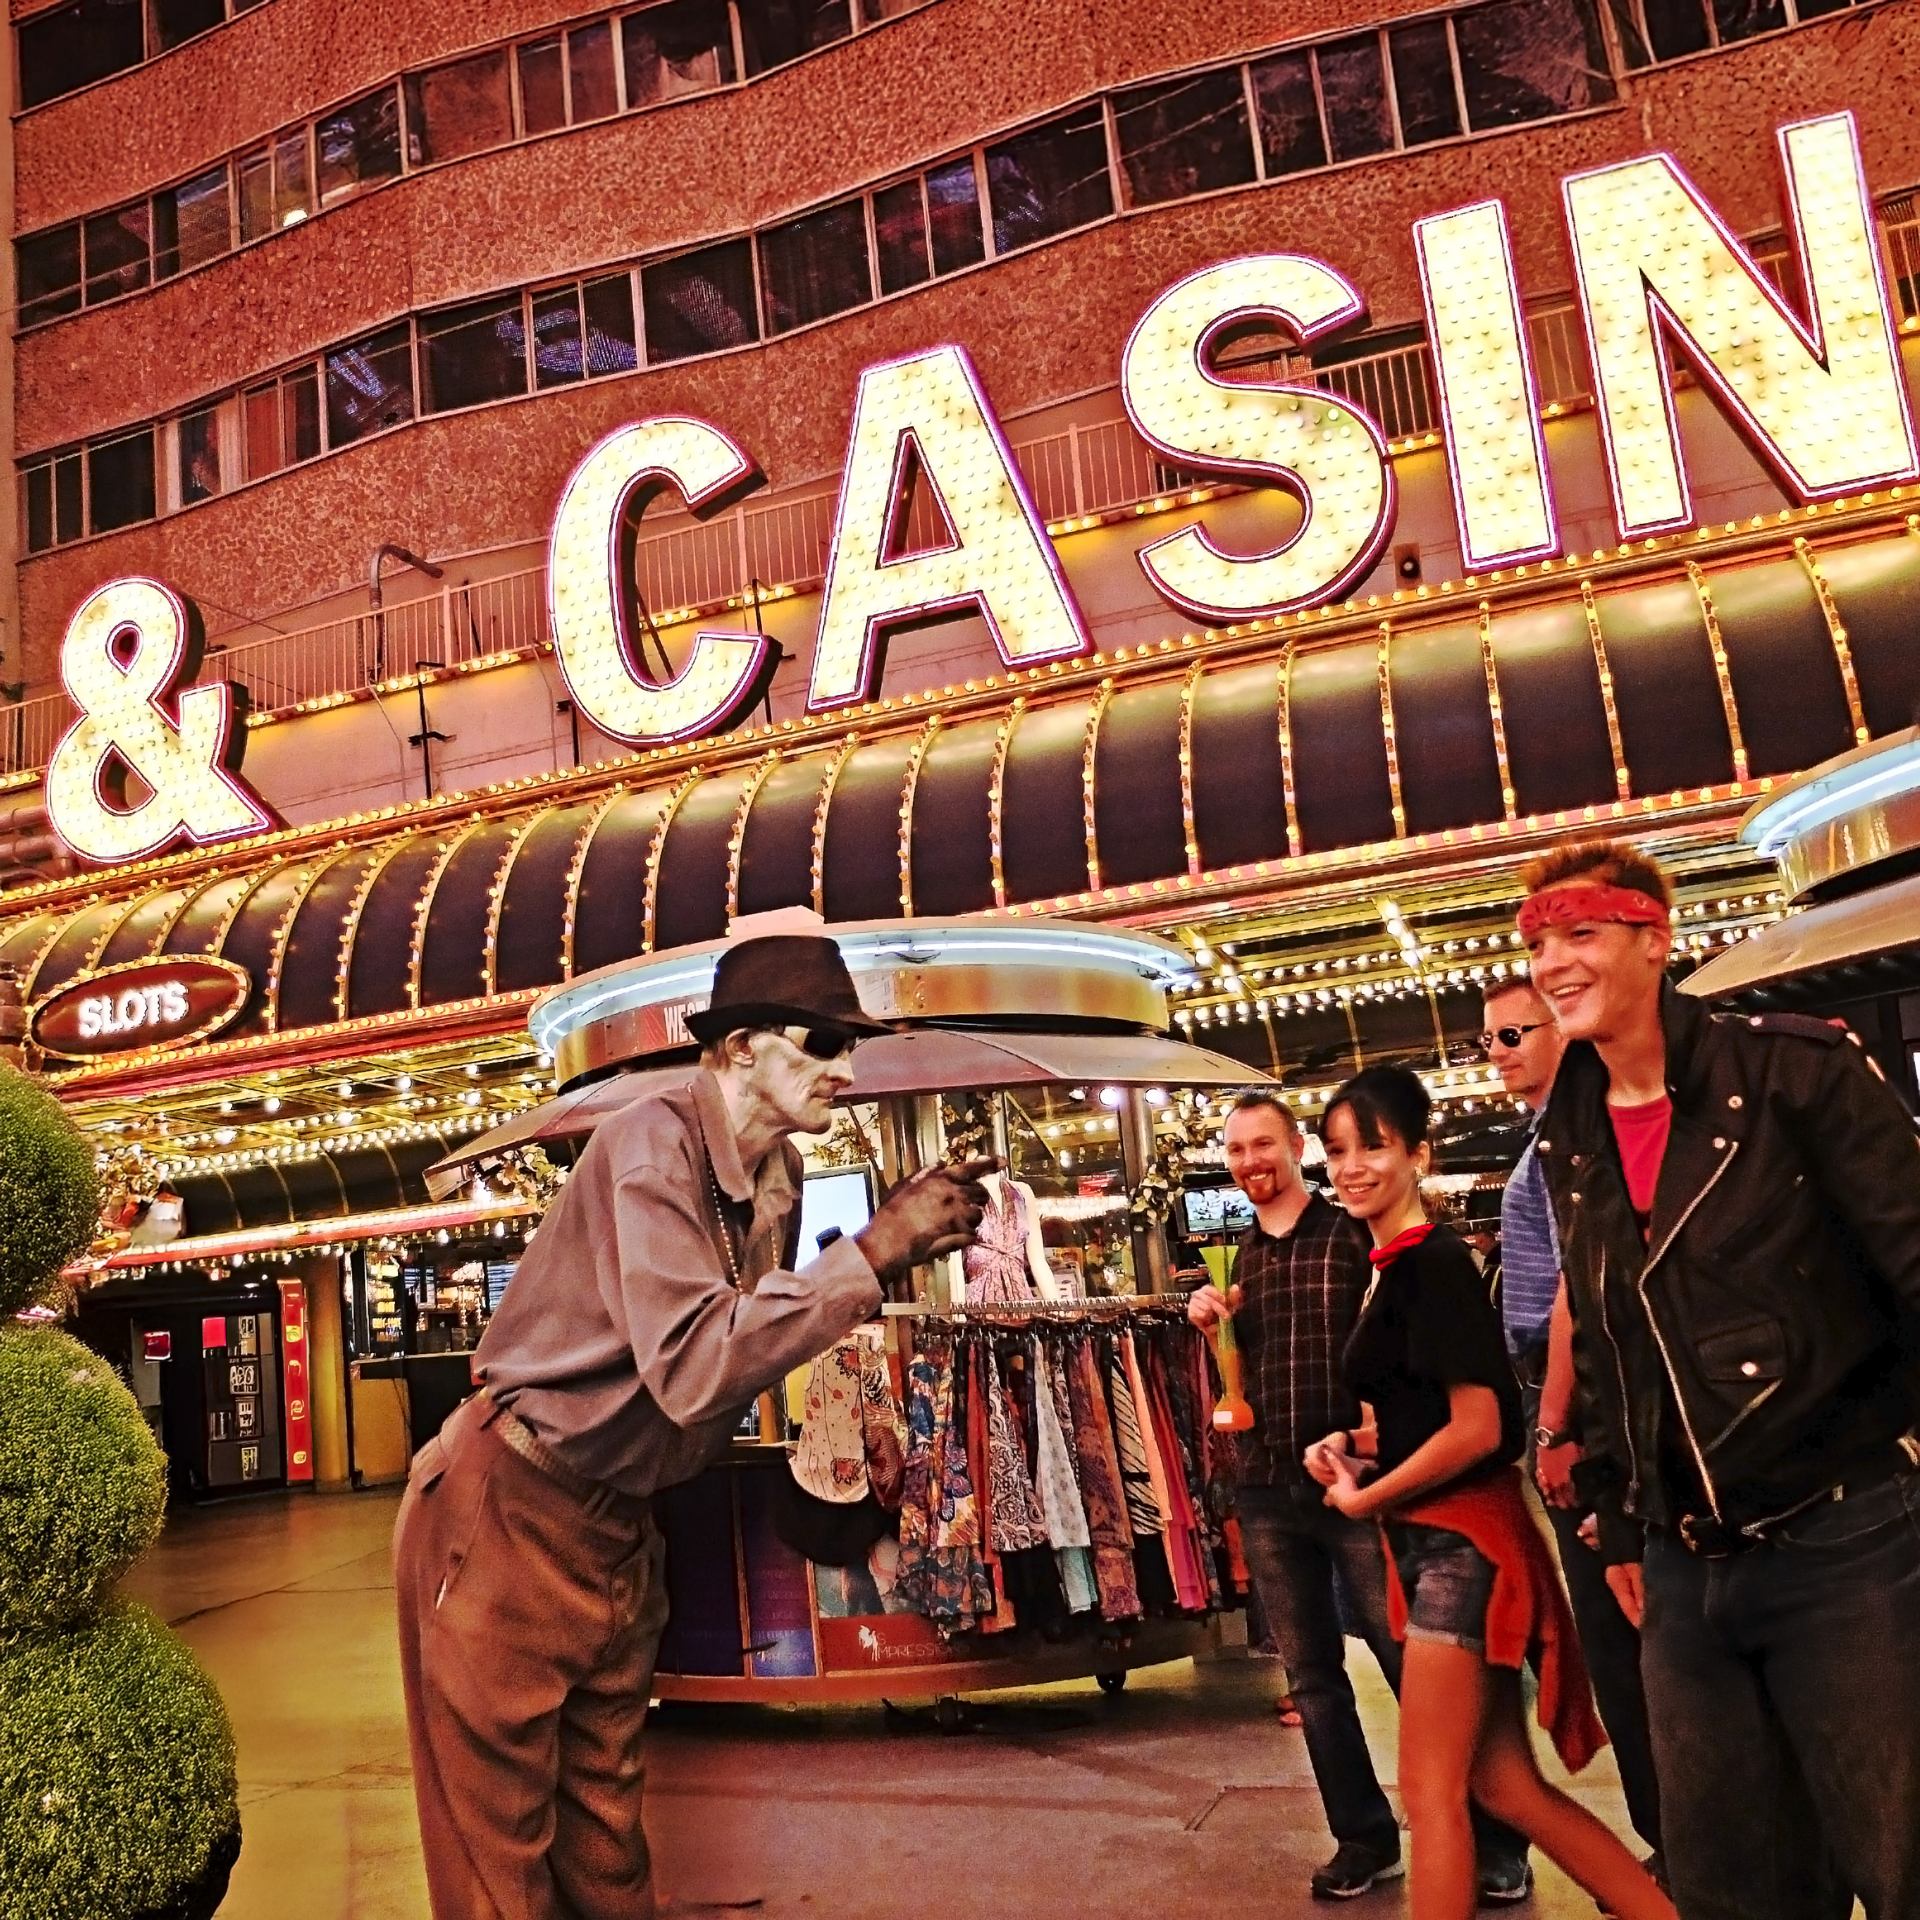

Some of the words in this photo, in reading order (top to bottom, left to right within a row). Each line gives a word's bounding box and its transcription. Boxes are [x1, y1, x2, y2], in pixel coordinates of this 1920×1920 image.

[45, 576, 270, 863] &
[546, 109, 1919, 746] CASIN
[78, 981, 189, 1038] SLOTS
[663, 1000, 707, 1045] WE
